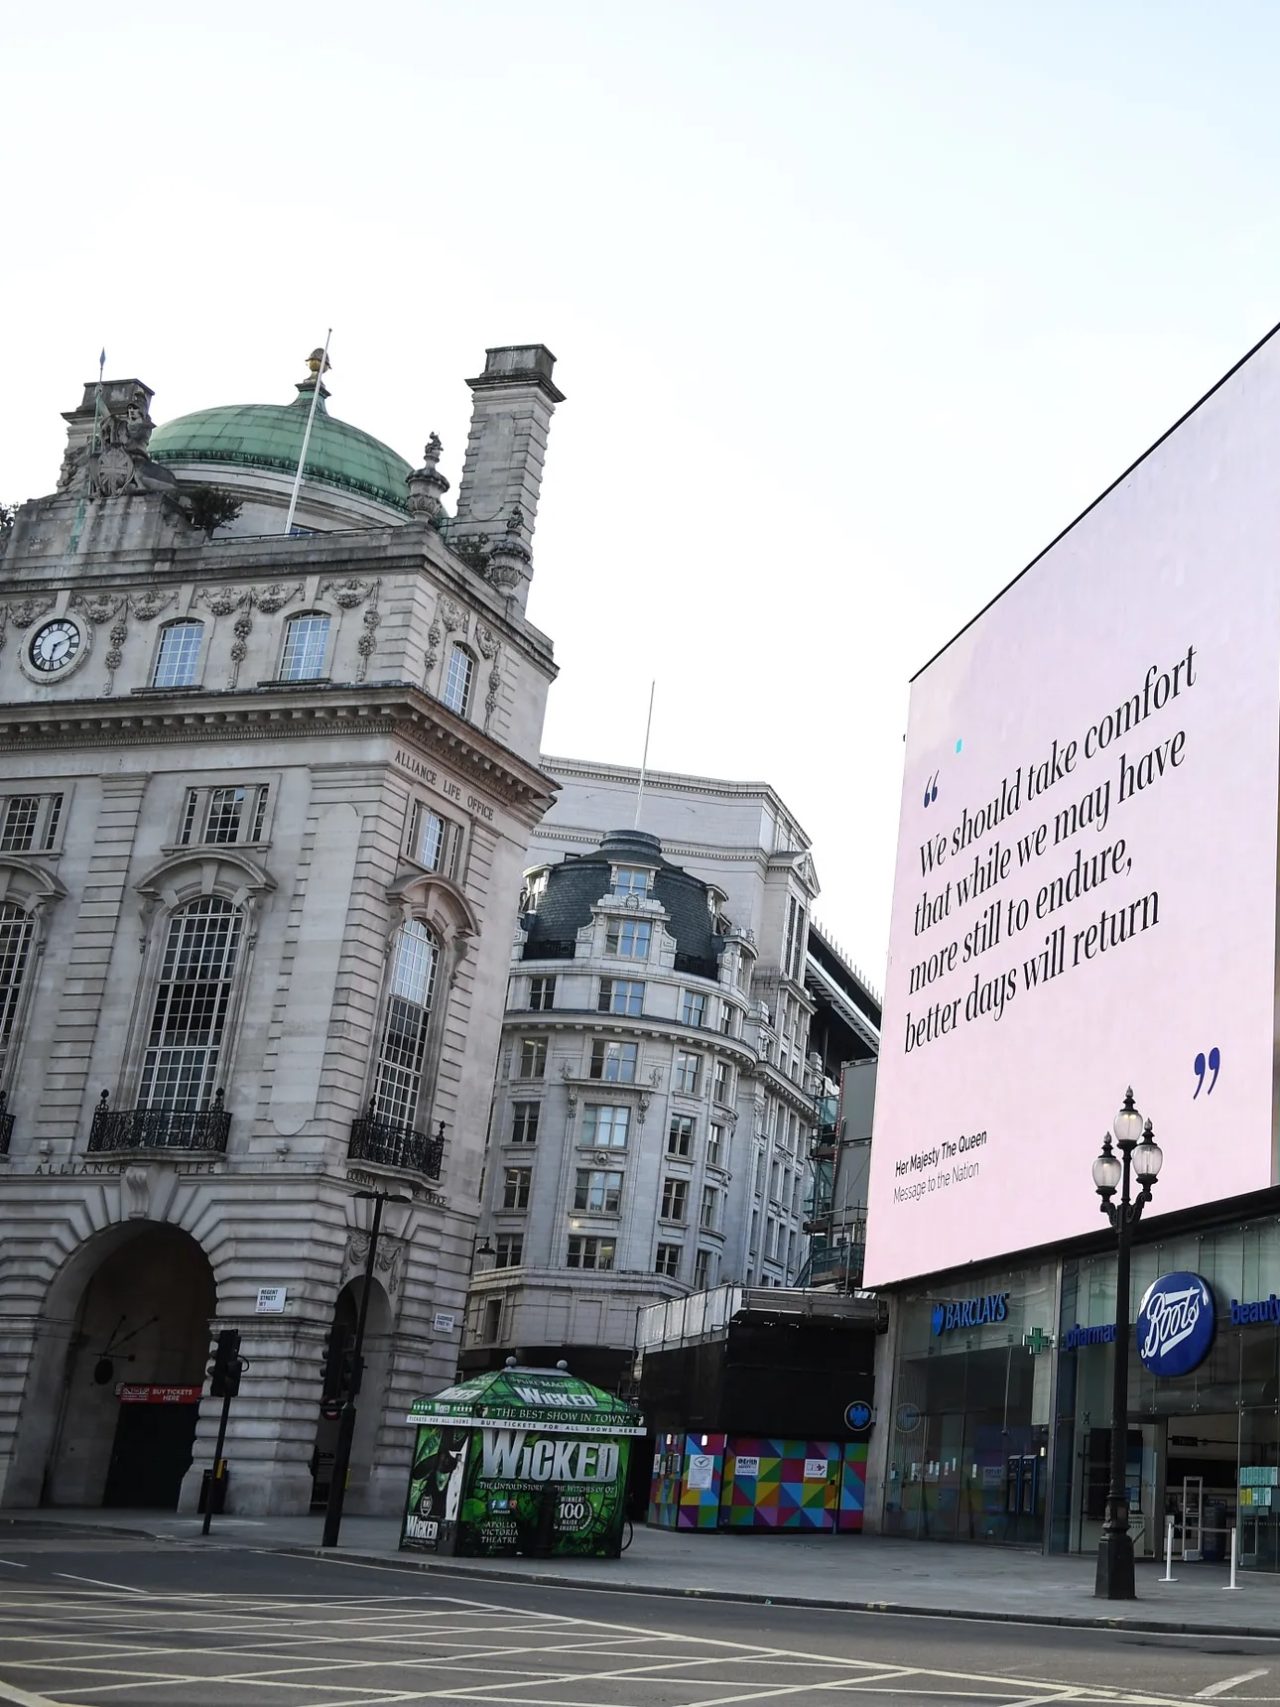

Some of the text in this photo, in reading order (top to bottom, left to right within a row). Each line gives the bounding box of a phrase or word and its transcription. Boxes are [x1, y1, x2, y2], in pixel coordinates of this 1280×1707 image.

[919, 644, 1197, 878] We should take comfort
[394, 750, 494, 821] ALLIANCE LIFE OFFICE
[913, 730, 1186, 937] that while we may have
[908, 838, 1133, 996] more still to endure,
[904, 890, 1160, 1055] better days will return
[34, 1162, 215, 1175] ALLIANCE LIFE
[895, 1130, 988, 1178] Her Majesty The Queen
[893, 1161, 980, 1204] Message to the Nation
[945, 1293, 1009, 1330] BARCLAYS
[1140, 1286, 1201, 1359] Boots
[1066, 1323, 1118, 1350] pharmac
[504, 1421, 537, 1429] TICKETS
[519, 1409, 545, 1419] BEST
[549, 1411, 578, 1421] SHOW
[580, 1412, 592, 1422] IN
[478, 1429, 620, 1483] WICKED
[558, 1503, 585, 1519] 100
